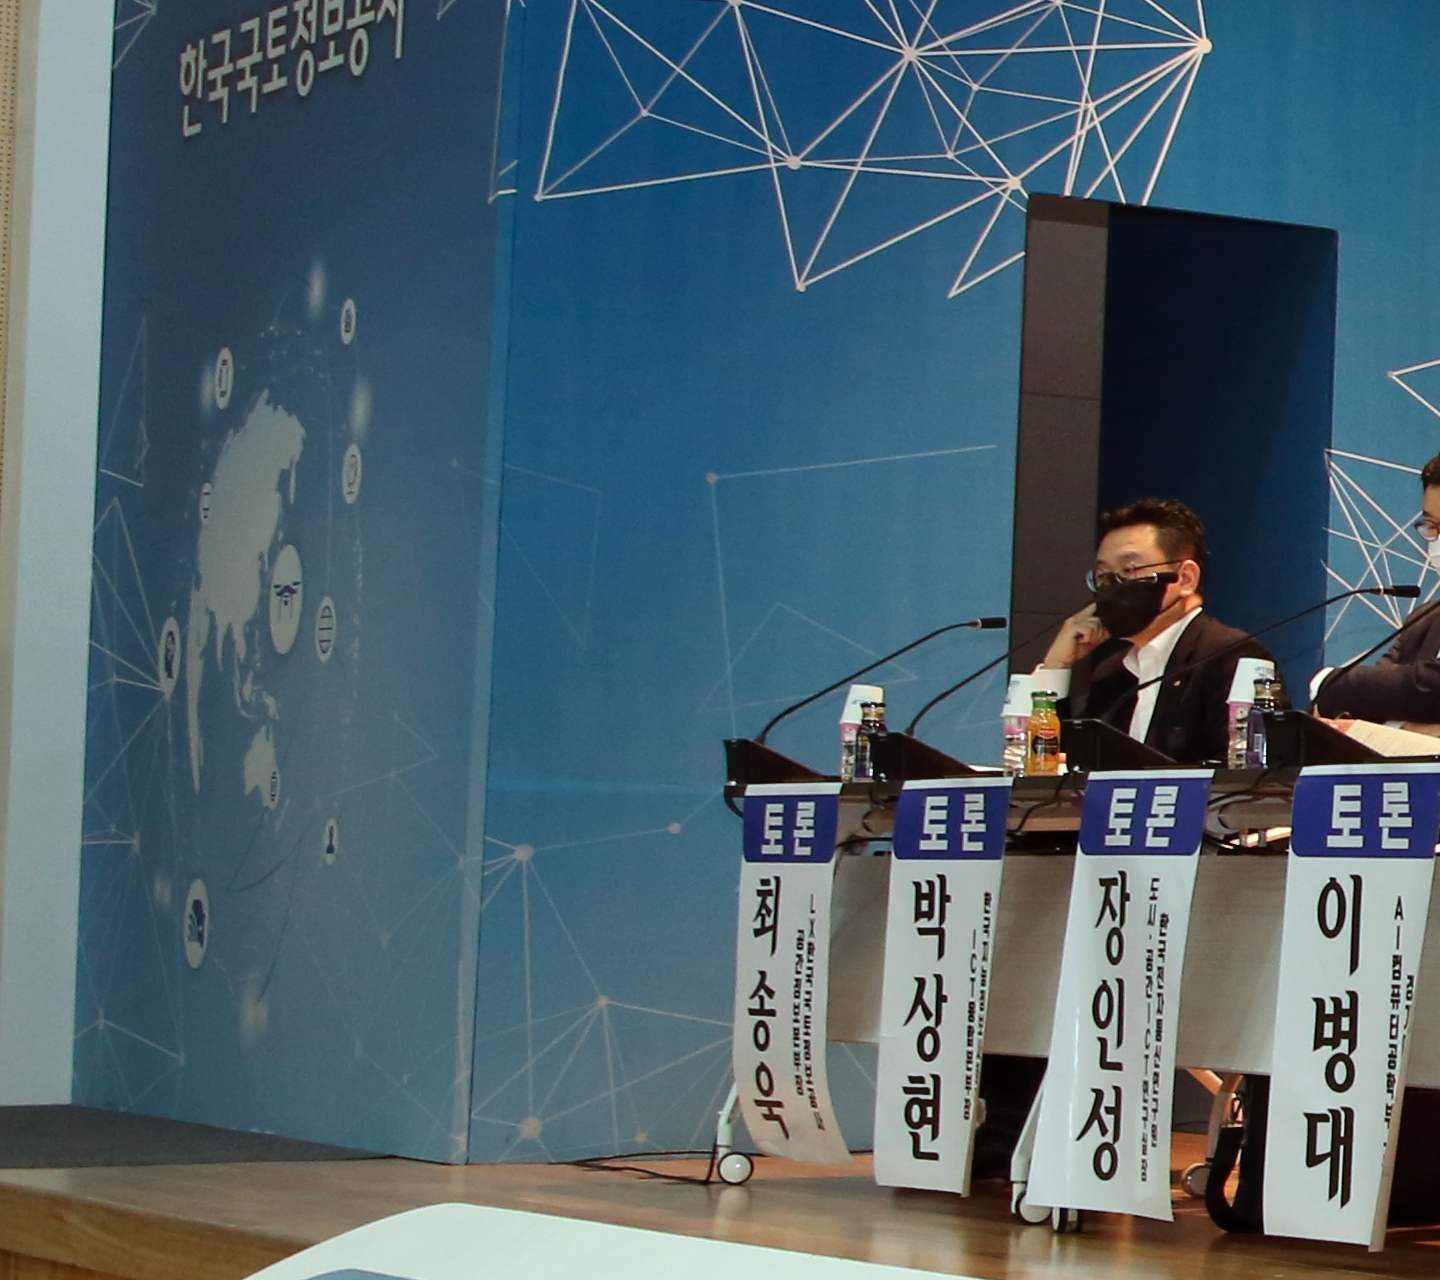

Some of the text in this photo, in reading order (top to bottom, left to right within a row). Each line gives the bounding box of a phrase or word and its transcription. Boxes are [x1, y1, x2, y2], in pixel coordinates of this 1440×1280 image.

[748, 876, 789, 1140] 최송욱
[902, 874, 951, 1160] 박상현
[1076, 871, 1130, 1181] 장인성
[1304, 875, 1362, 1208] 이병대
